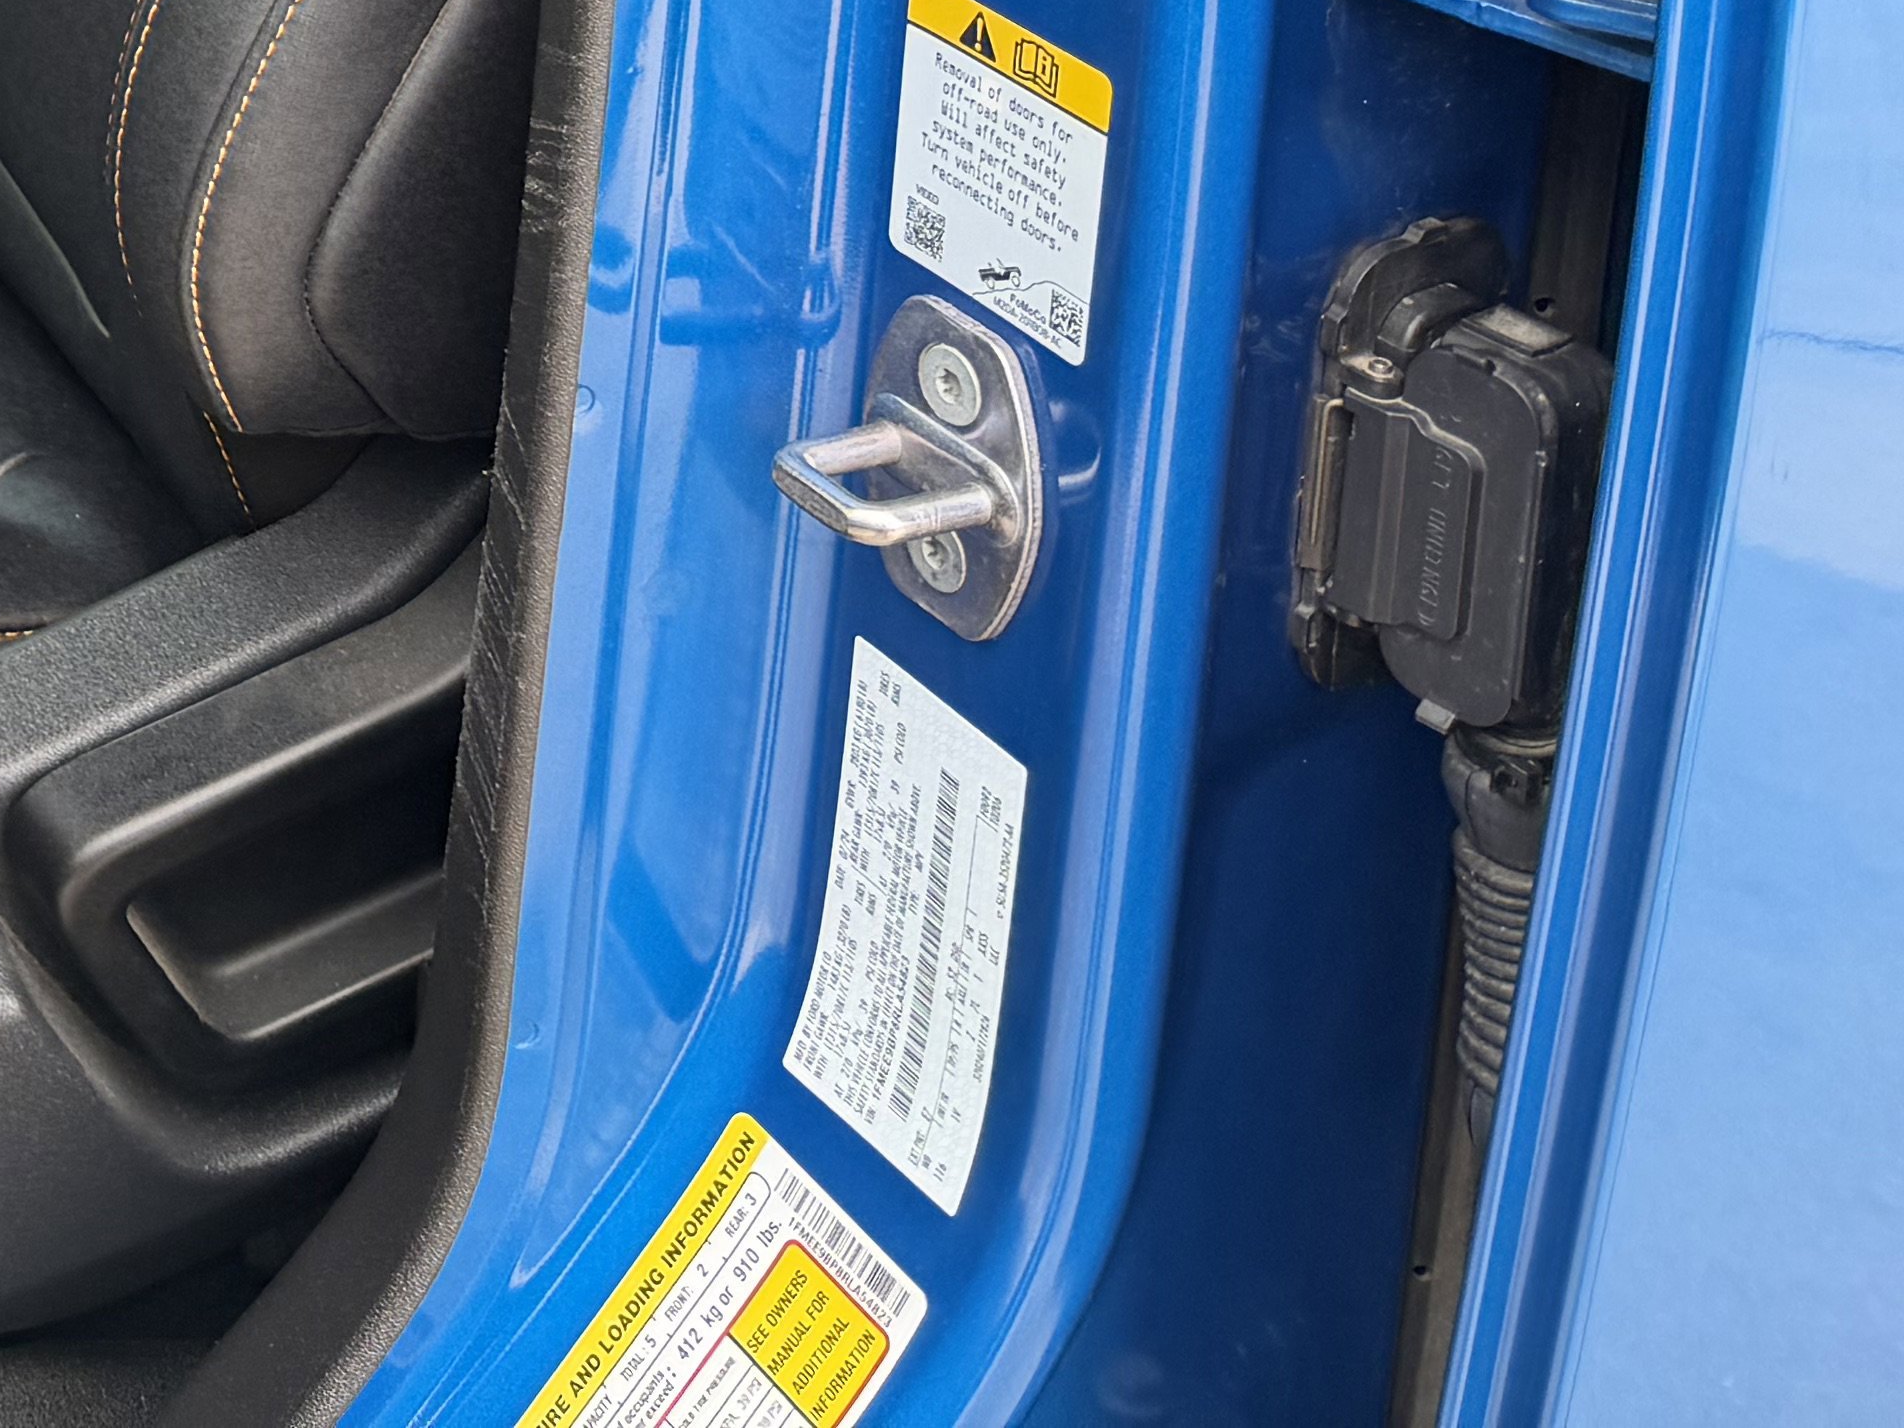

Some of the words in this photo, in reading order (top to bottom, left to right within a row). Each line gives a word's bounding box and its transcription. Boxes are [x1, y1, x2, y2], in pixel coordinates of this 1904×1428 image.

[934, 52, 982, 93] Removal
[987, 86, 1002, 103] of
[1008, 97, 1044, 129] doors
[1051, 120, 1073, 144] for
[942, 81, 998, 124] off-road
[1003, 118, 1026, 141] use
[1031, 135, 1066, 164] only.
[921, 131, 949, 161] Turn
[954, 155, 1003, 195] vehicle
[1007, 188, 1029, 209] off
[1035, 202, 1079, 242] before
[932, 120, 974, 154] system
[979, 148, 1062, 207] performance.
[940, 99, 968, 129] Will
[974, 123, 1016, 158] affect
[1023, 152, 1066, 190] safety
[931, 164, 1014, 227] reconnecting
[1020, 217, 1062, 252] doors.
[569, 1353, 601, 1398] AND
[598, 1268, 664, 1354] LOADING
[661, 1131, 754, 1267] INFORMATION
[643, 1333, 657, 1349] 5
[695, 1262, 709, 1278] 2
[724, 1206, 749, 1238] REAR:
[744, 1192, 757, 1206] 3
[677, 1327, 703, 1360] 412
[699, 1304, 724, 1328] kg
[718, 1285, 734, 1306] or
[732, 1247, 760, 1282] 910
[755, 1221, 782, 1248] lbs.
[746, 1323, 770, 1354] SEE
[765, 1269, 808, 1327] OWNERS
[766, 1320, 812, 1375] MANUAL
[805, 1290, 830, 1321] FOR
[792, 1318, 850, 1395] ADDITIONAL
[809, 1329, 875, 1421] INFORMATION
